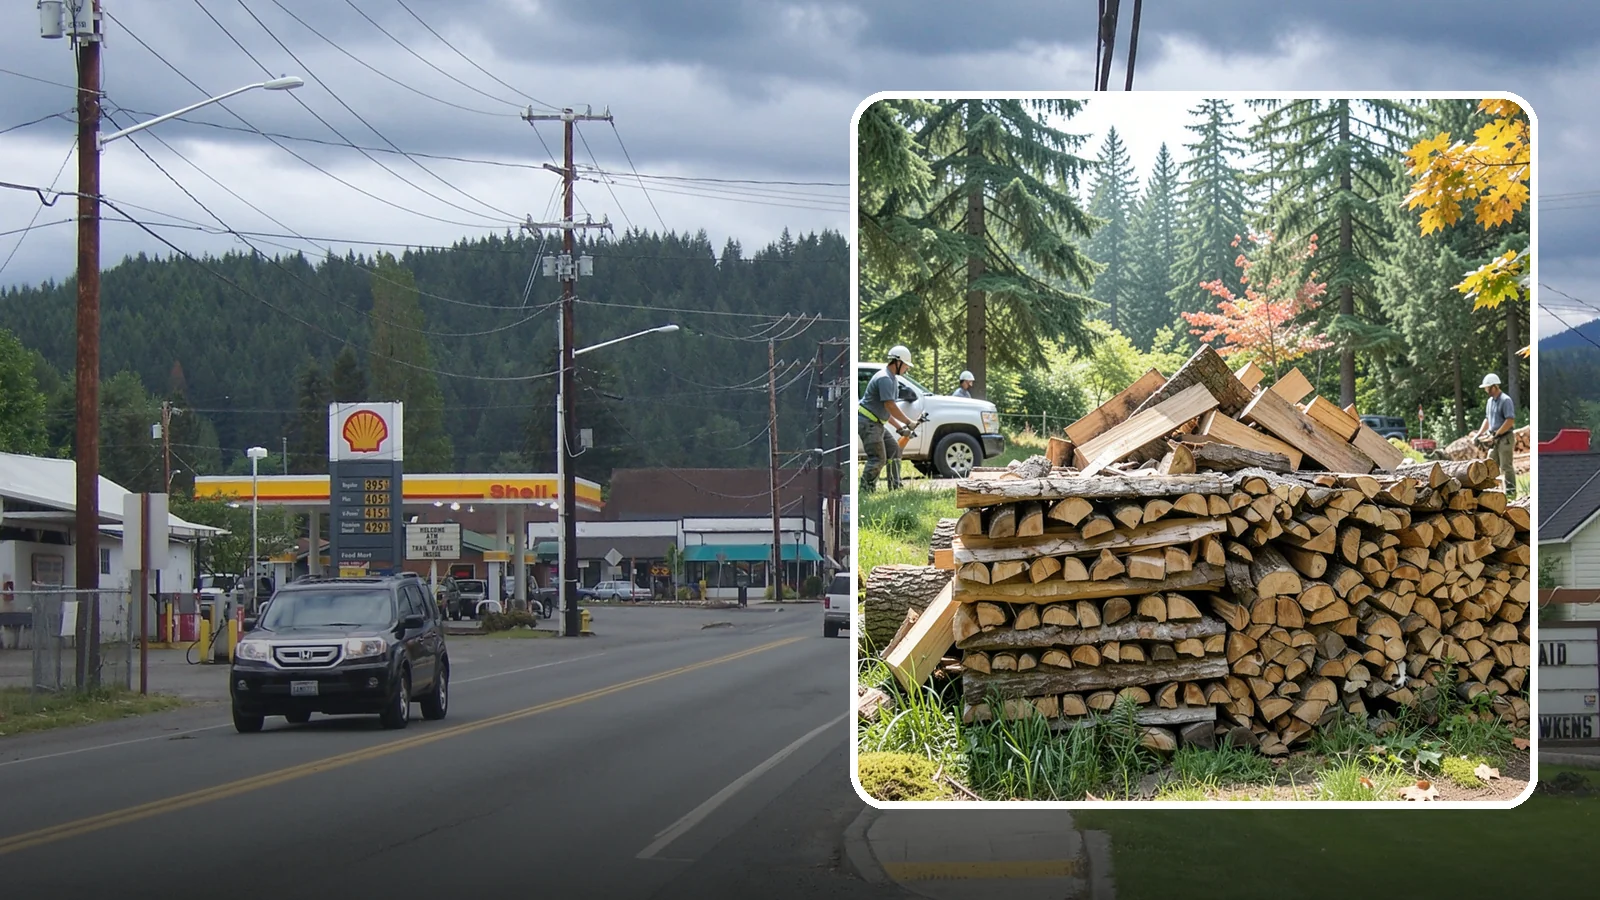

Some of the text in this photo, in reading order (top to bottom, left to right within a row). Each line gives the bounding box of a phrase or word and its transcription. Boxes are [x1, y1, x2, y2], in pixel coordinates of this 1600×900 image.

[366, 480, 384, 490] 395
[490, 484, 547, 499] Shell
[366, 494, 384, 504] 405
[366, 508, 384, 518] 415
[366, 522, 384, 533] 429
